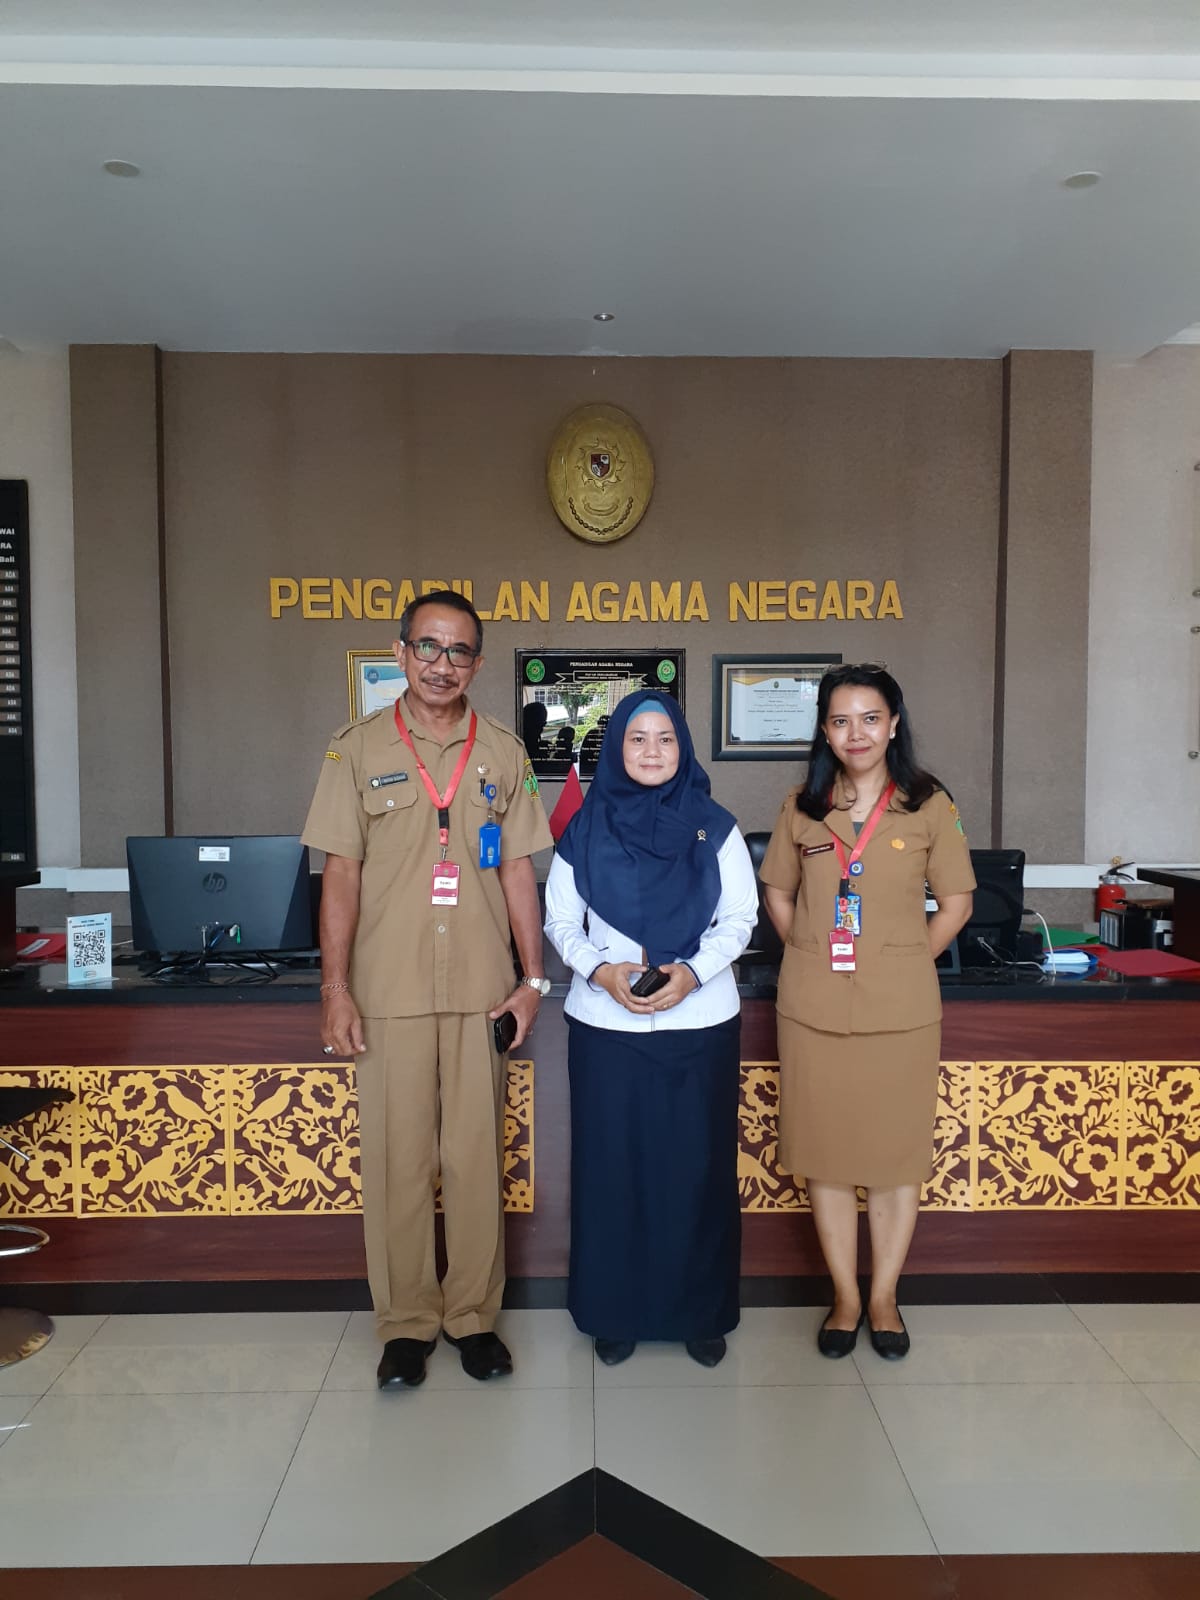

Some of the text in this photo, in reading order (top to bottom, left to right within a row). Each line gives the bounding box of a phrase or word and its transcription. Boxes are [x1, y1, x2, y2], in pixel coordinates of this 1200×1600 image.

[566, 581, 709, 622] AGAMA
[729, 580, 904, 620] NEGARA
[206, 872, 226, 894] hp
